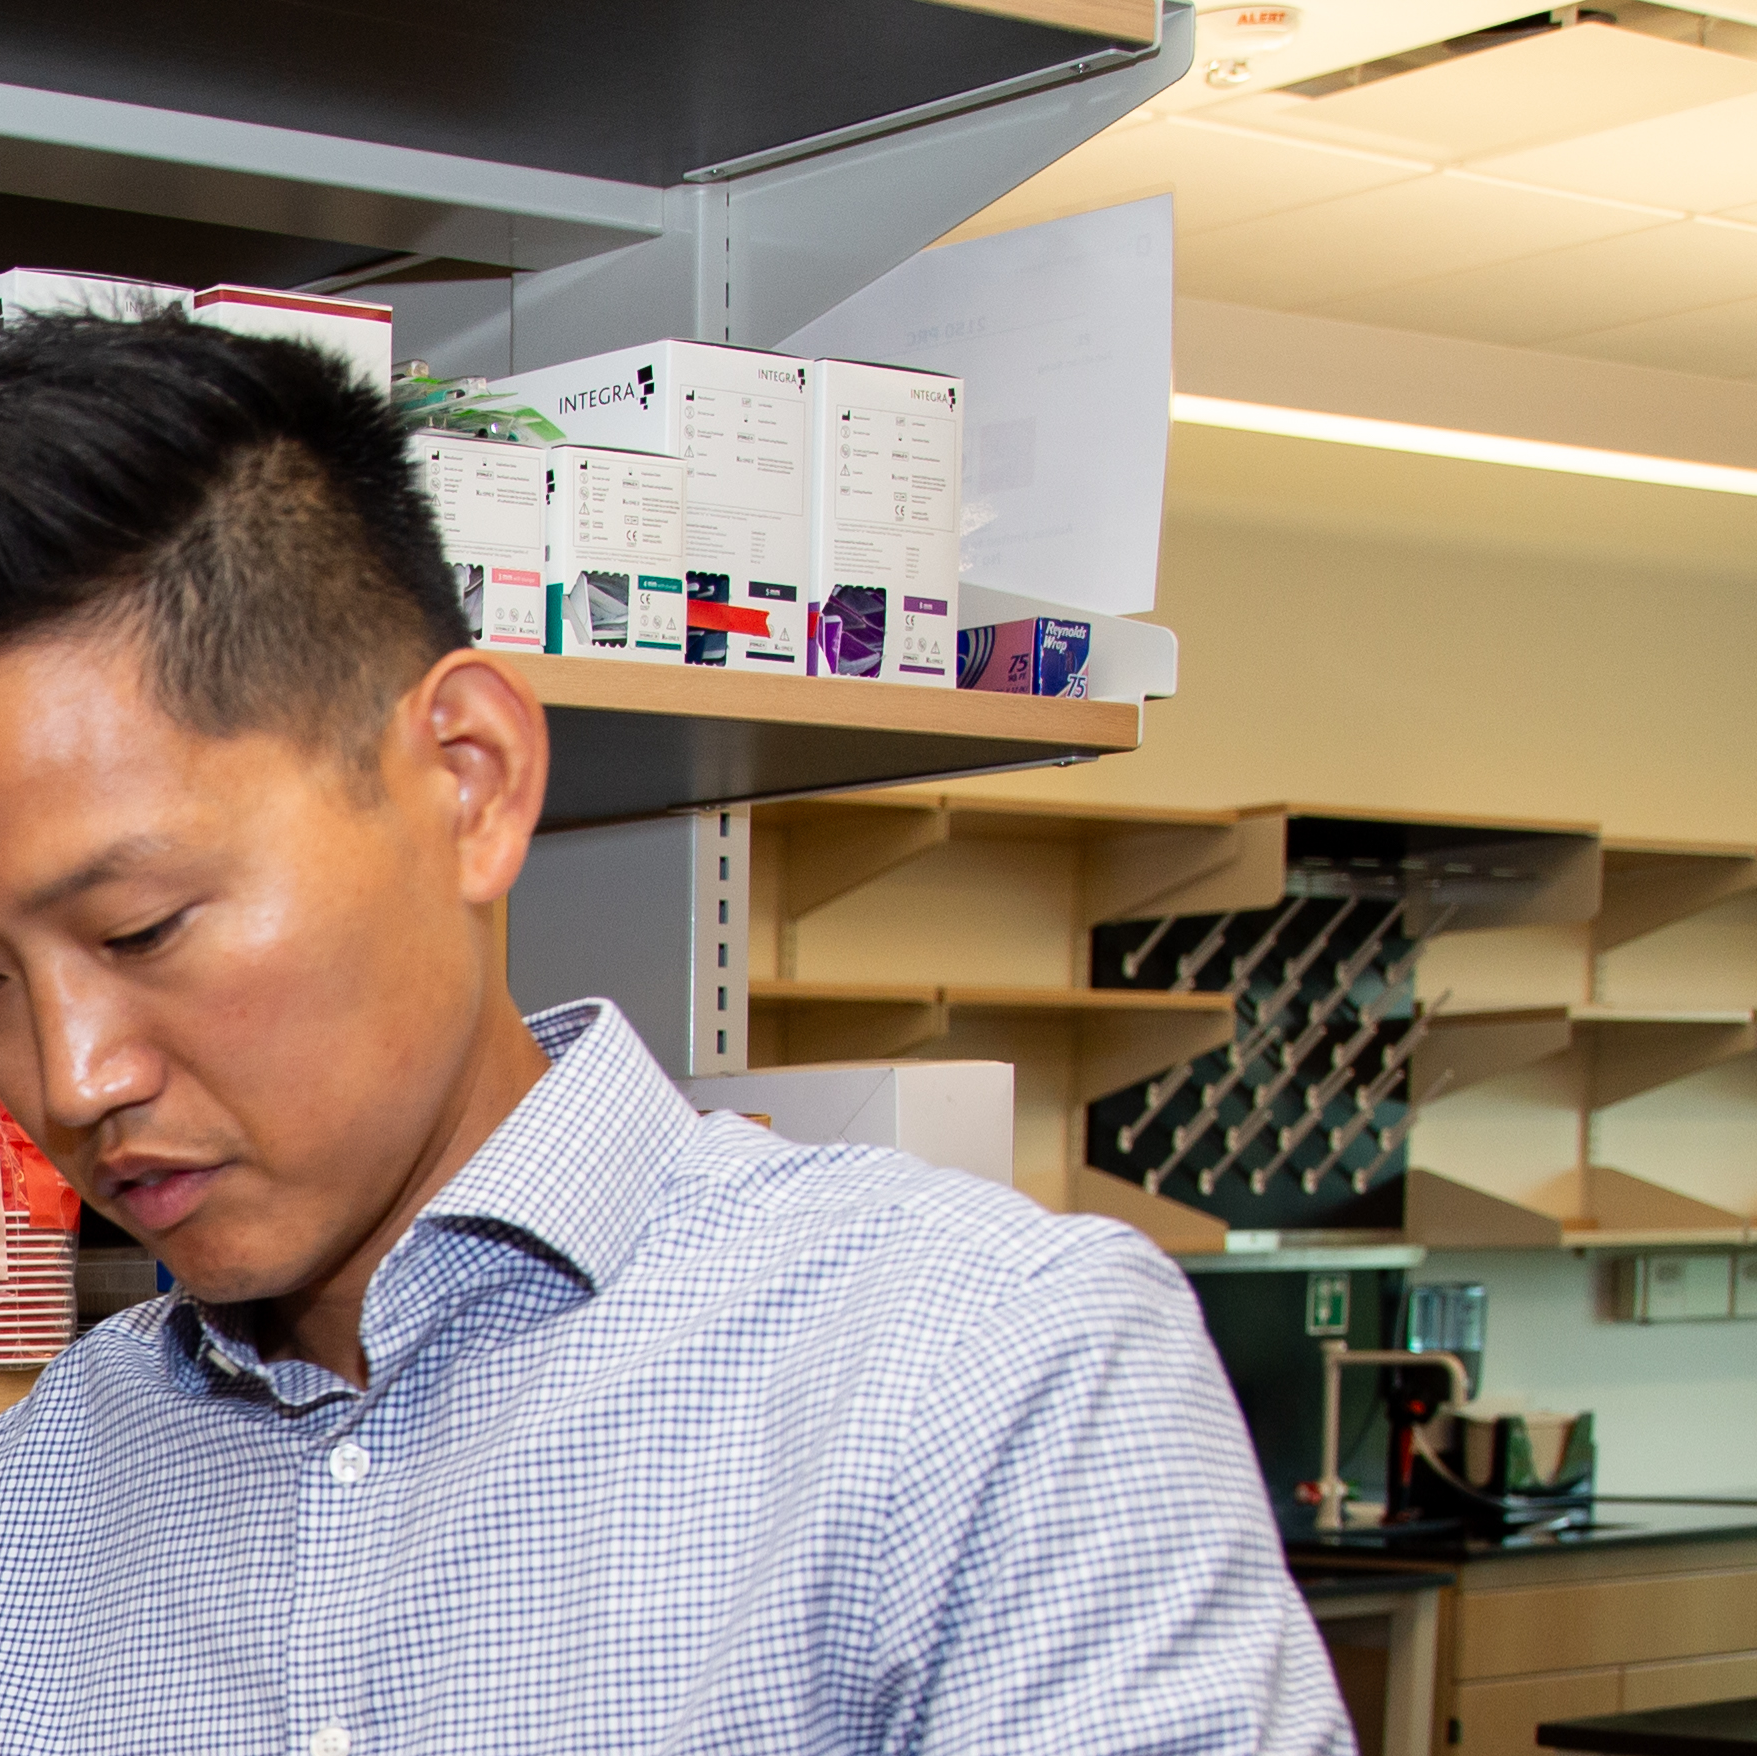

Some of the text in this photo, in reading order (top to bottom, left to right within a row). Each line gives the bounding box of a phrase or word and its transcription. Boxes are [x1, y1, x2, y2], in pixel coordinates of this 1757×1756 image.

[1237, 11, 1286, 26] ALERT
[758, 369, 797, 384] INTEGRA
[559, 382, 635, 415] INTEGRA
[911, 388, 948, 403] INTEGRA
[1045, 620, 1087, 640] Reynolds
[1042, 635, 1067, 654] Wrap
[1008, 653, 1030, 674] 75
[1066, 673, 1087, 699] 75
